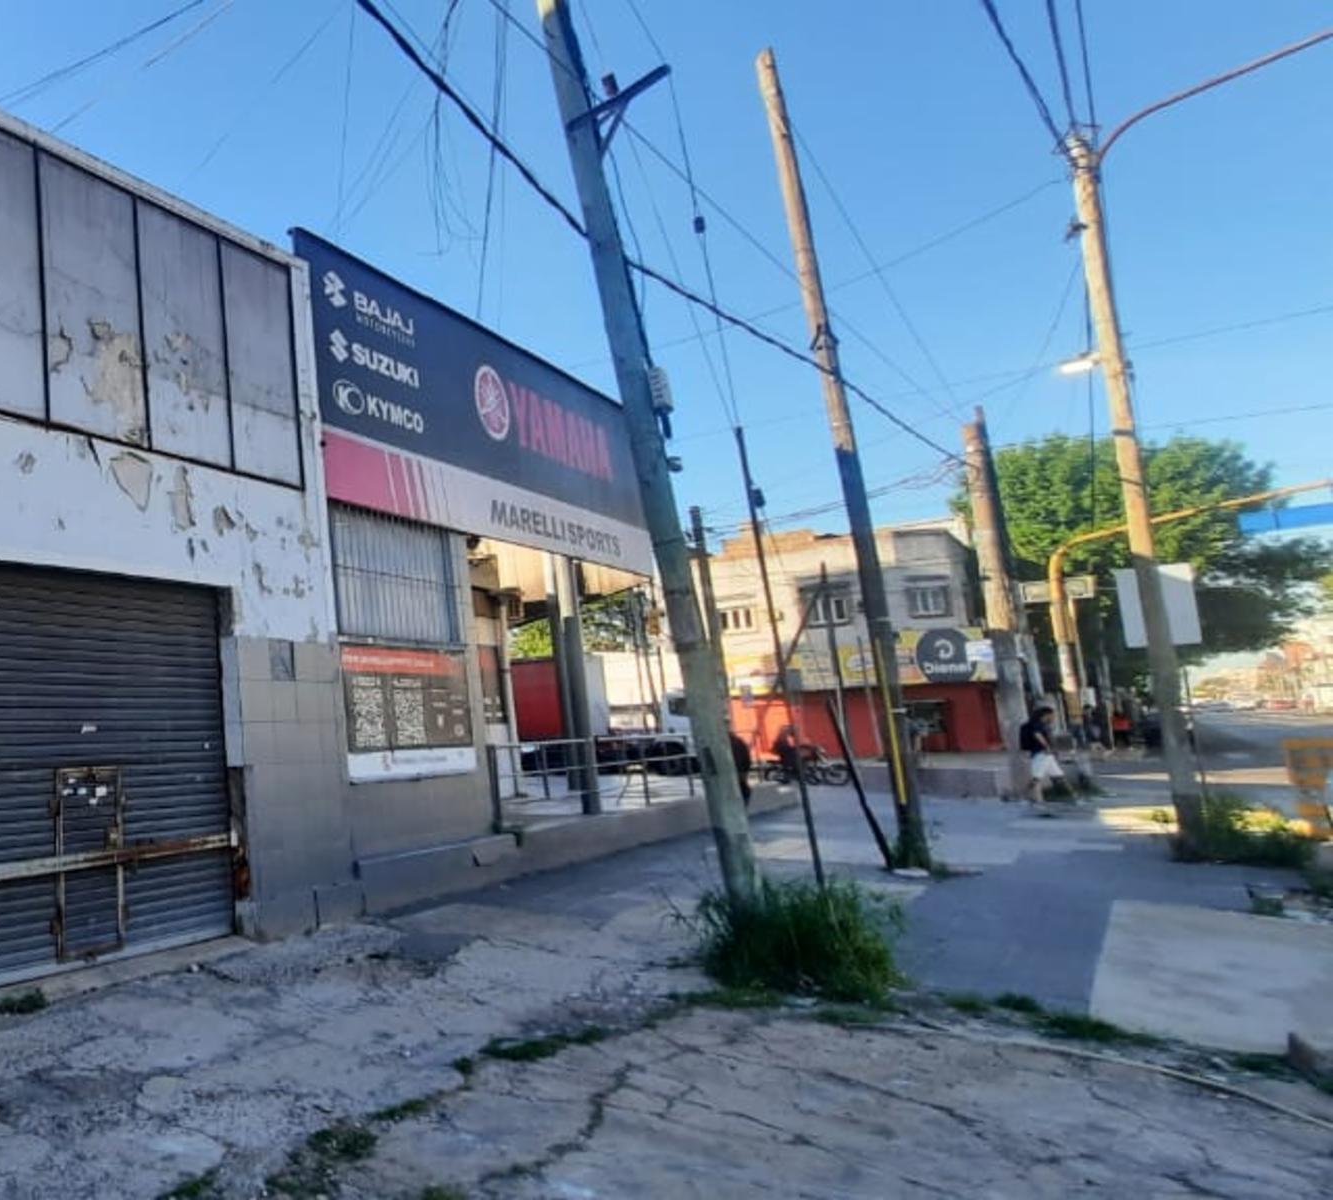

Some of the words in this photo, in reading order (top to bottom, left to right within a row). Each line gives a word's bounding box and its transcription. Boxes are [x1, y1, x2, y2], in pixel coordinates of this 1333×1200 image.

[353, 290, 414, 336] BAJAJ
[351, 342, 420, 390] SUZUKI
[367, 393, 425, 434] KYMCO
[507, 380, 614, 482] YAMAHA
[490, 499, 566, 540] MARELLI
[567, 523, 622, 557] SPORTS
